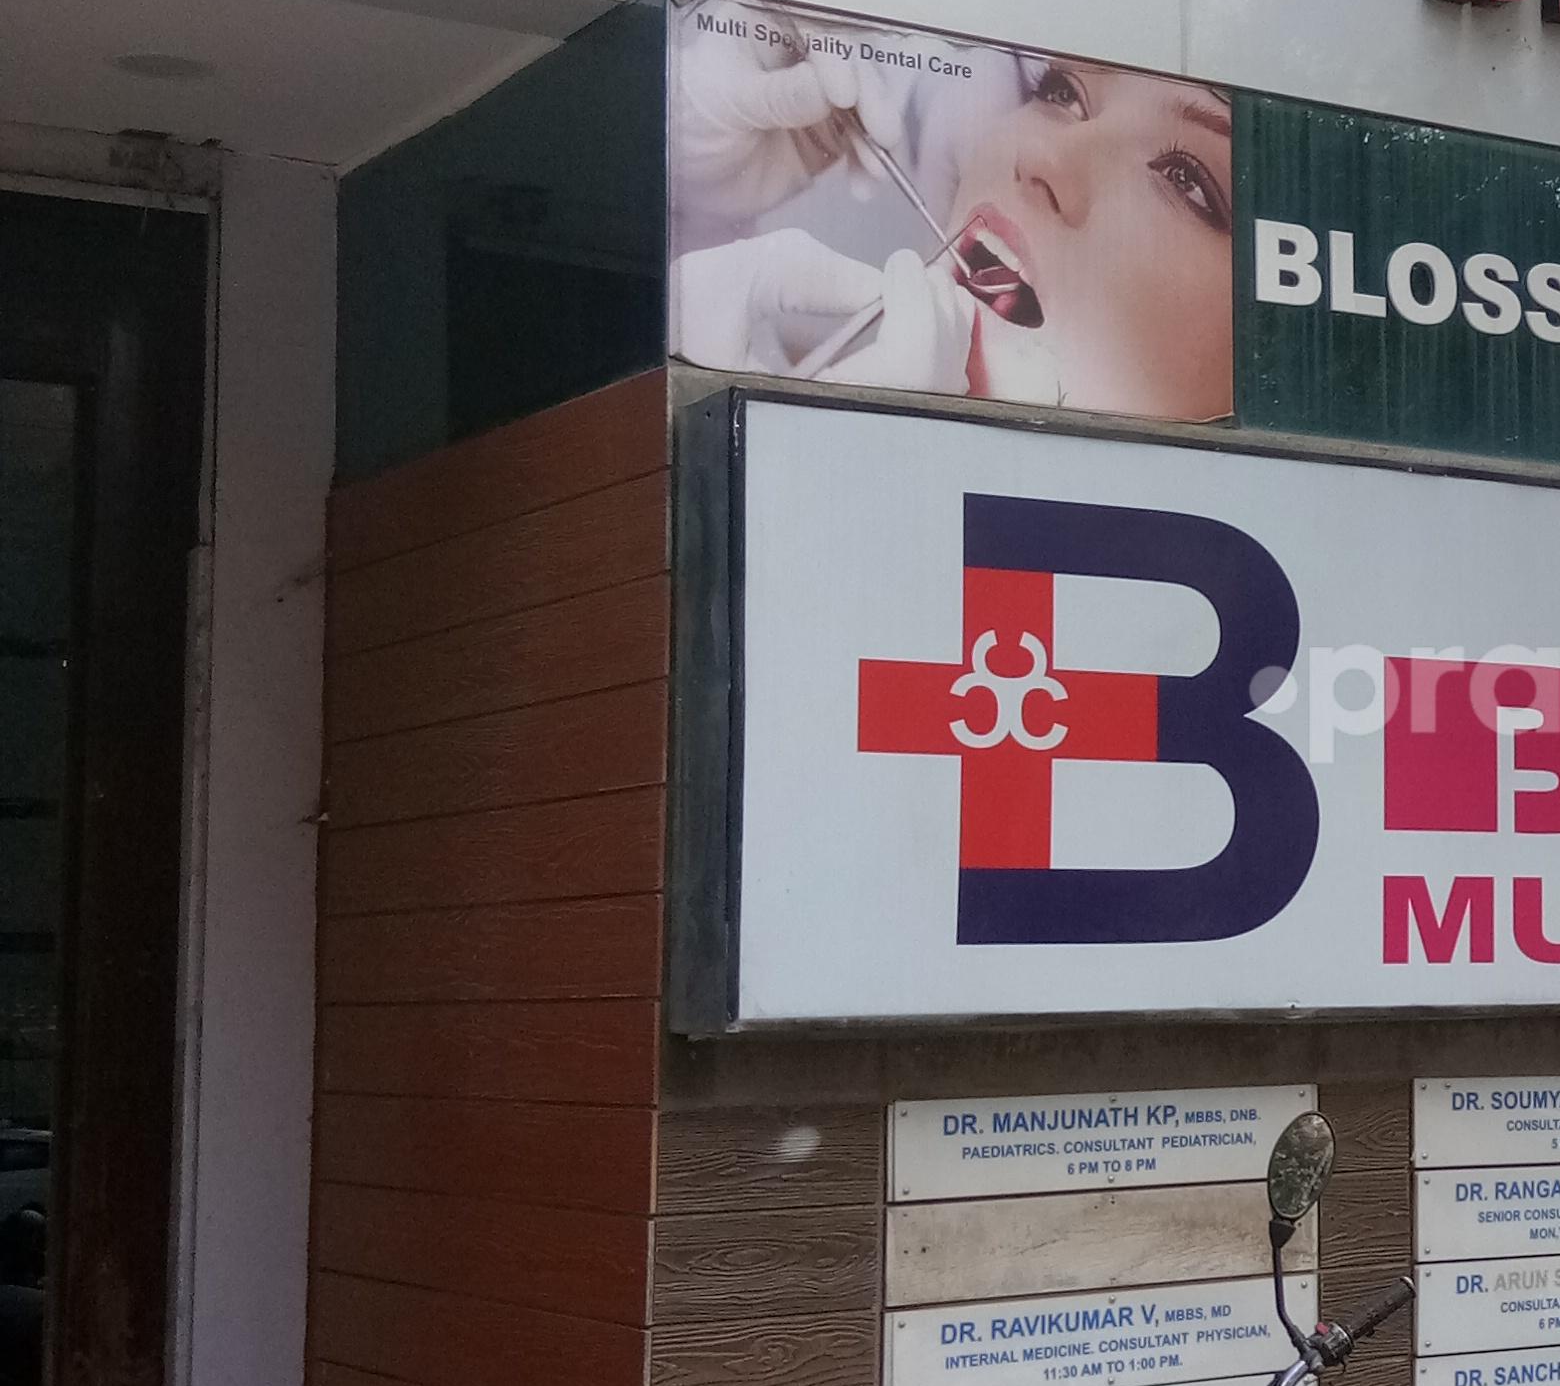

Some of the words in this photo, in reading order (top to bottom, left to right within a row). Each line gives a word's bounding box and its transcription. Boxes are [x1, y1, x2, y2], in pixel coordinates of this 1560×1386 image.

[696, 13, 747, 39] Multi
[754, 25, 853, 60] Speiality
[860, 44, 922, 70] Dental
[928, 56, 972, 79] Care
[1452, 1092, 1484, 1110] DR.
[943, 1114, 984, 1135] DR.
[992, 1107, 1139, 1134] MANJUNATH
[1146, 1105, 1179, 1128] KP,
[1185, 1111, 1226, 1125] MBBS,
[1230, 1109, 1261, 1121] DNB.
[1063, 1137, 1154, 1154] CONSULTANT
[1162, 1132, 1256, 1148] PEDIATRICIAN,
[1551, 1138, 1558, 1149] 5
[1067, 1162, 1075, 1175] 6
[1079, 1161, 1099, 1174] PM
[1102, 1160, 1121, 1173] TO
[1125, 1160, 1133, 1171] 8
[1136, 1158, 1156, 1171] PM
[1456, 1183, 1488, 1202] DR.
[1478, 1210, 1520, 1222] SENIOR
[1457, 1275, 1488, 1294] DR.
[1493, 1270, 1547, 1292] ARUN
[941, 1322, 982, 1345] DR.
[991, 1307, 1134, 1340] RAVIKUMAR
[1140, 1304, 1159, 1327] V,
[1165, 1308, 1207, 1323] MBBS,
[1212, 1305, 1232, 1317] MD
[1538, 1320, 1545, 1329] 6
[945, 1350, 1018, 1370] INTERNAL
[1099, 1333, 1189, 1353] CONSULTANT
[1196, 1325, 1271, 1343] PHYSICIAN,
[1043, 1367, 1078, 1381] 11:30
[1081, 1364, 1102, 1378] AM
[1106, 1361, 1125, 1375] TO
[1131, 1357, 1156, 1373] 1:00
[1159, 1355, 1183, 1369] PM.
